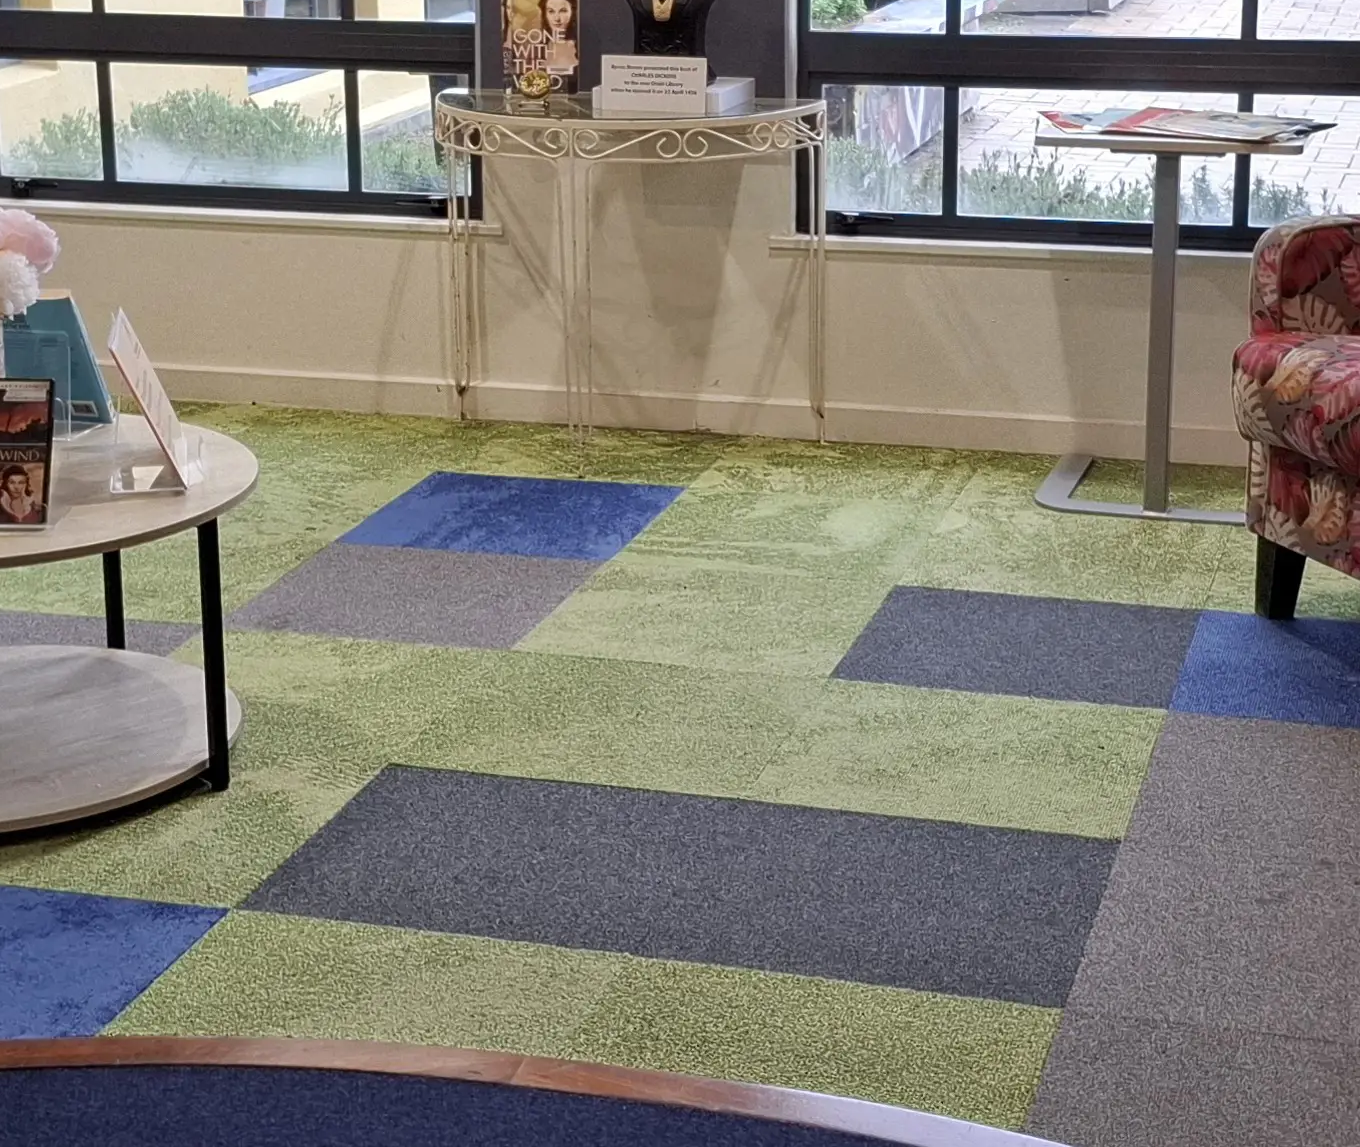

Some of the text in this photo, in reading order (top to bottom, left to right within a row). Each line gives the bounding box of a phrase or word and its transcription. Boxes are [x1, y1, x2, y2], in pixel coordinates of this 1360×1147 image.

[513, 28, 566, 44] GONE
[512, 44, 557, 59] WITH
[512, 59, 547, 74] THE
[0, 448, 41, 461] WIND
